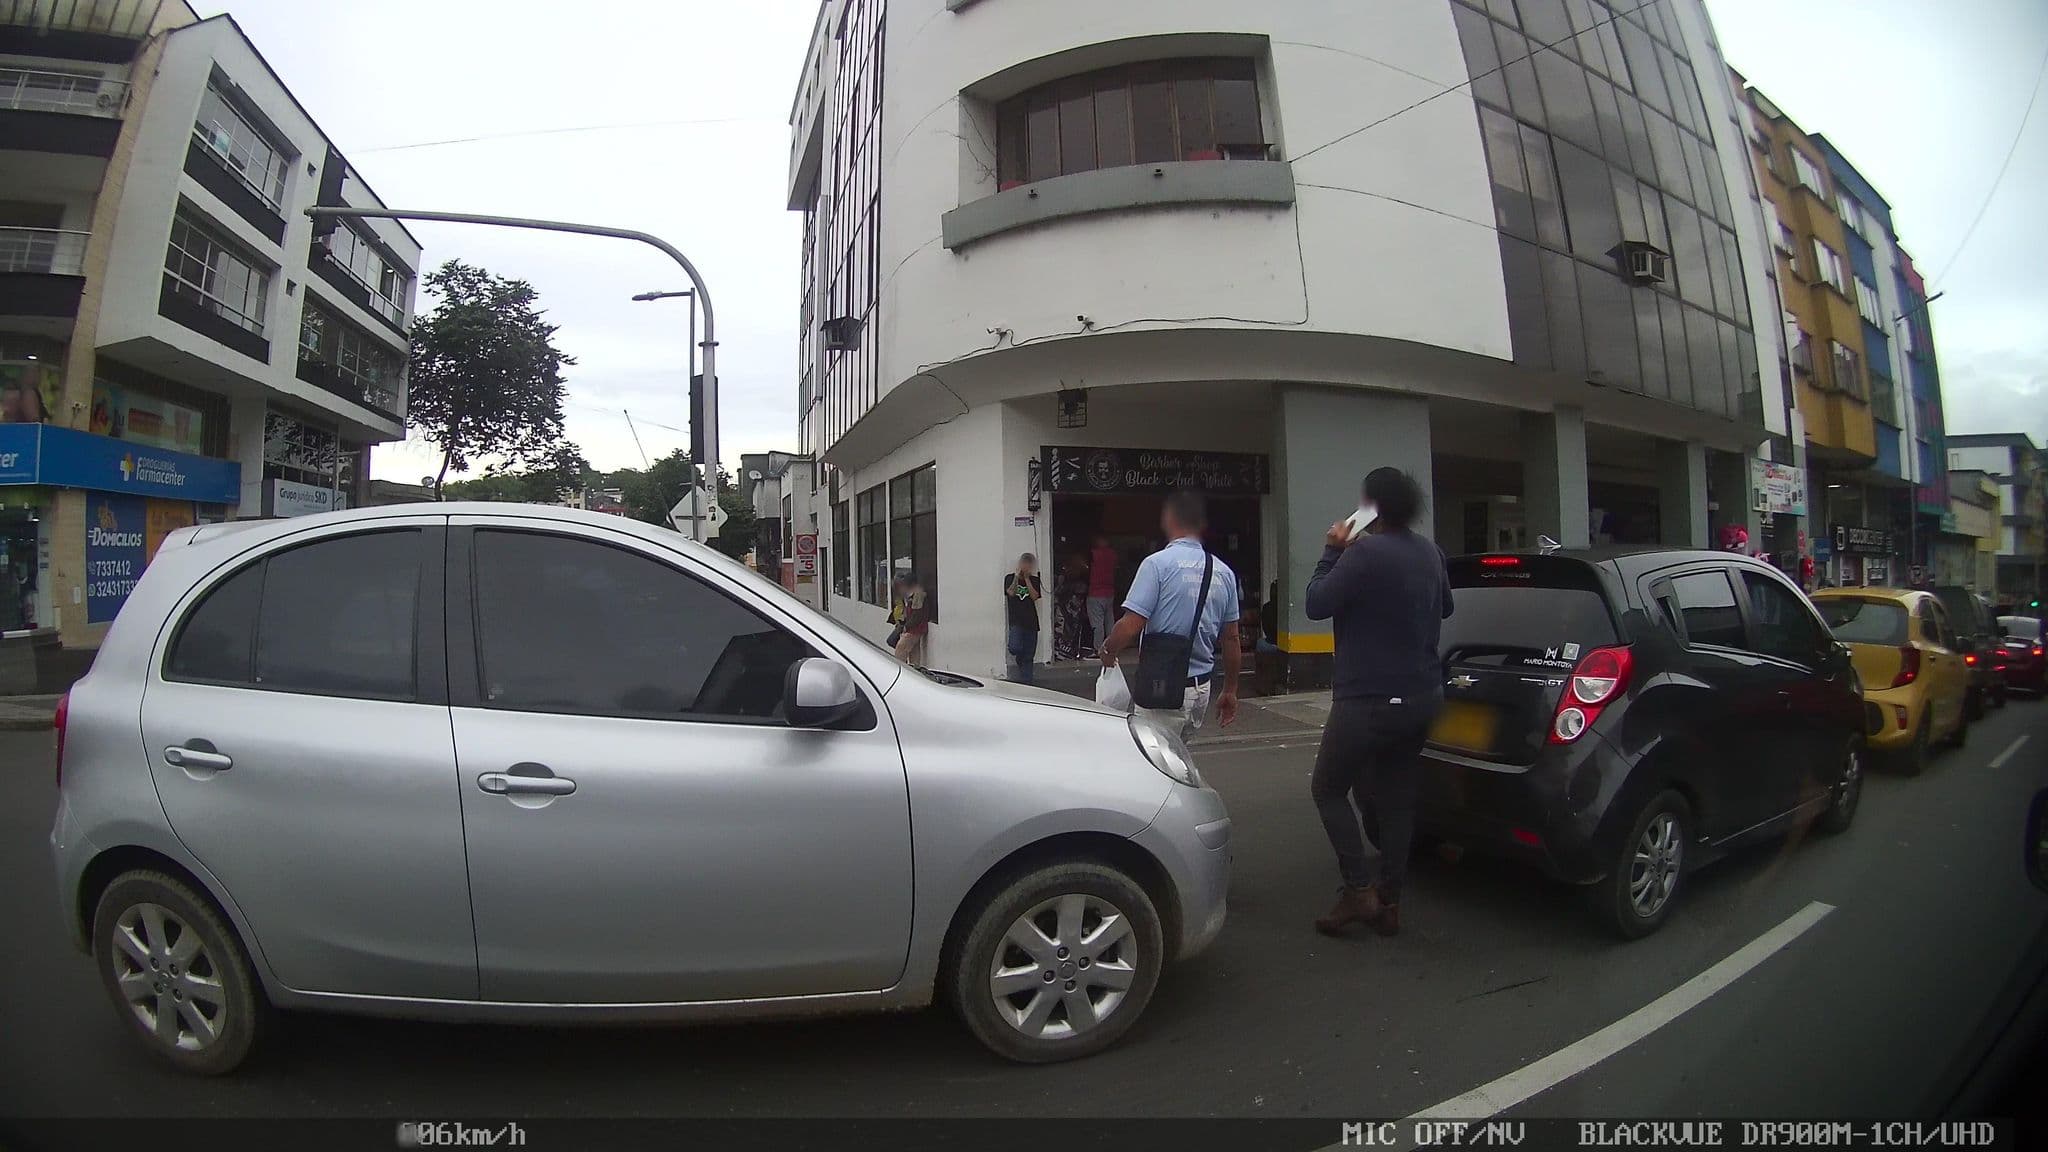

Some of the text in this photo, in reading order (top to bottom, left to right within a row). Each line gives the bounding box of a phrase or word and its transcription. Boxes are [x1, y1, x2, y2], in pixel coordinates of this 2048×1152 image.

[1139, 454, 1182, 471] Barber
[1185, 455, 1221, 473] Shop
[1125, 471, 1160, 488] Black
[1164, 471, 1195, 488] And
[1201, 471, 1234, 488] White
[92, 527, 142, 547] DOMICILIOS
[96, 560, 131, 577] 7337412
[96, 580, 138, 597] 32431733
[1543, 660, 1573, 669] MONTOYA
